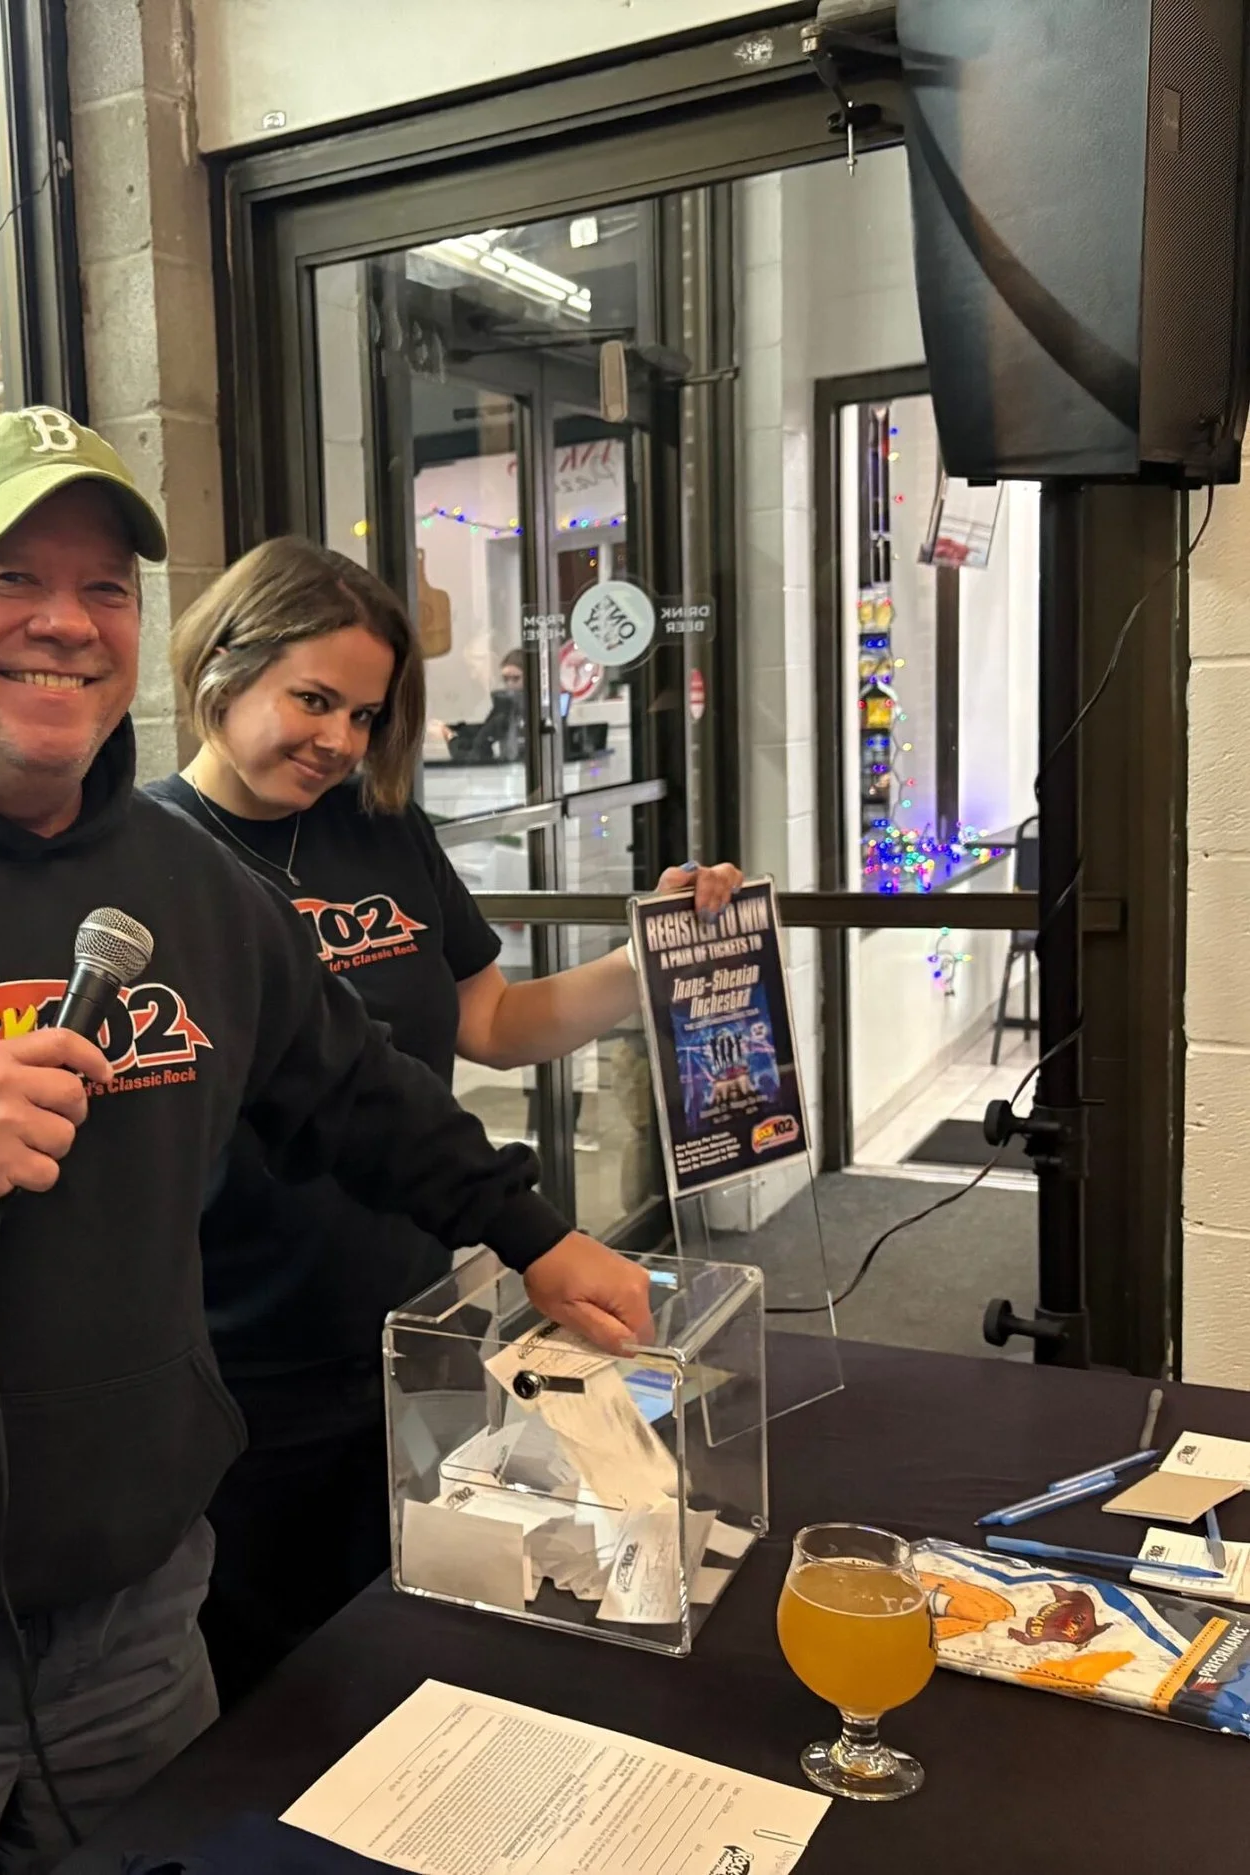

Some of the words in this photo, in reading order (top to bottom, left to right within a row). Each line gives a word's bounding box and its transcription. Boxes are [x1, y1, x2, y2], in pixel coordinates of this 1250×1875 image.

[18, 409, 78, 452] B
[737, 896, 770, 934] WIN
[352, 948, 393, 967] Classic
[394, 943, 419, 955] Rock
[661, 952, 669, 970] A
[669, 947, 694, 969] PAIR
[694, 944, 707, 963] OF
[707, 936, 748, 960] TICKETS
[747, 934, 762, 952] TO
[108, 1073, 162, 1095] Classic
[164, 1067, 197, 1084] Rock
[773, 1119, 793, 1136] 102
[621, 1541, 639, 1567] 102
[1198, 1626, 1249, 1677] PERFORMANCE
